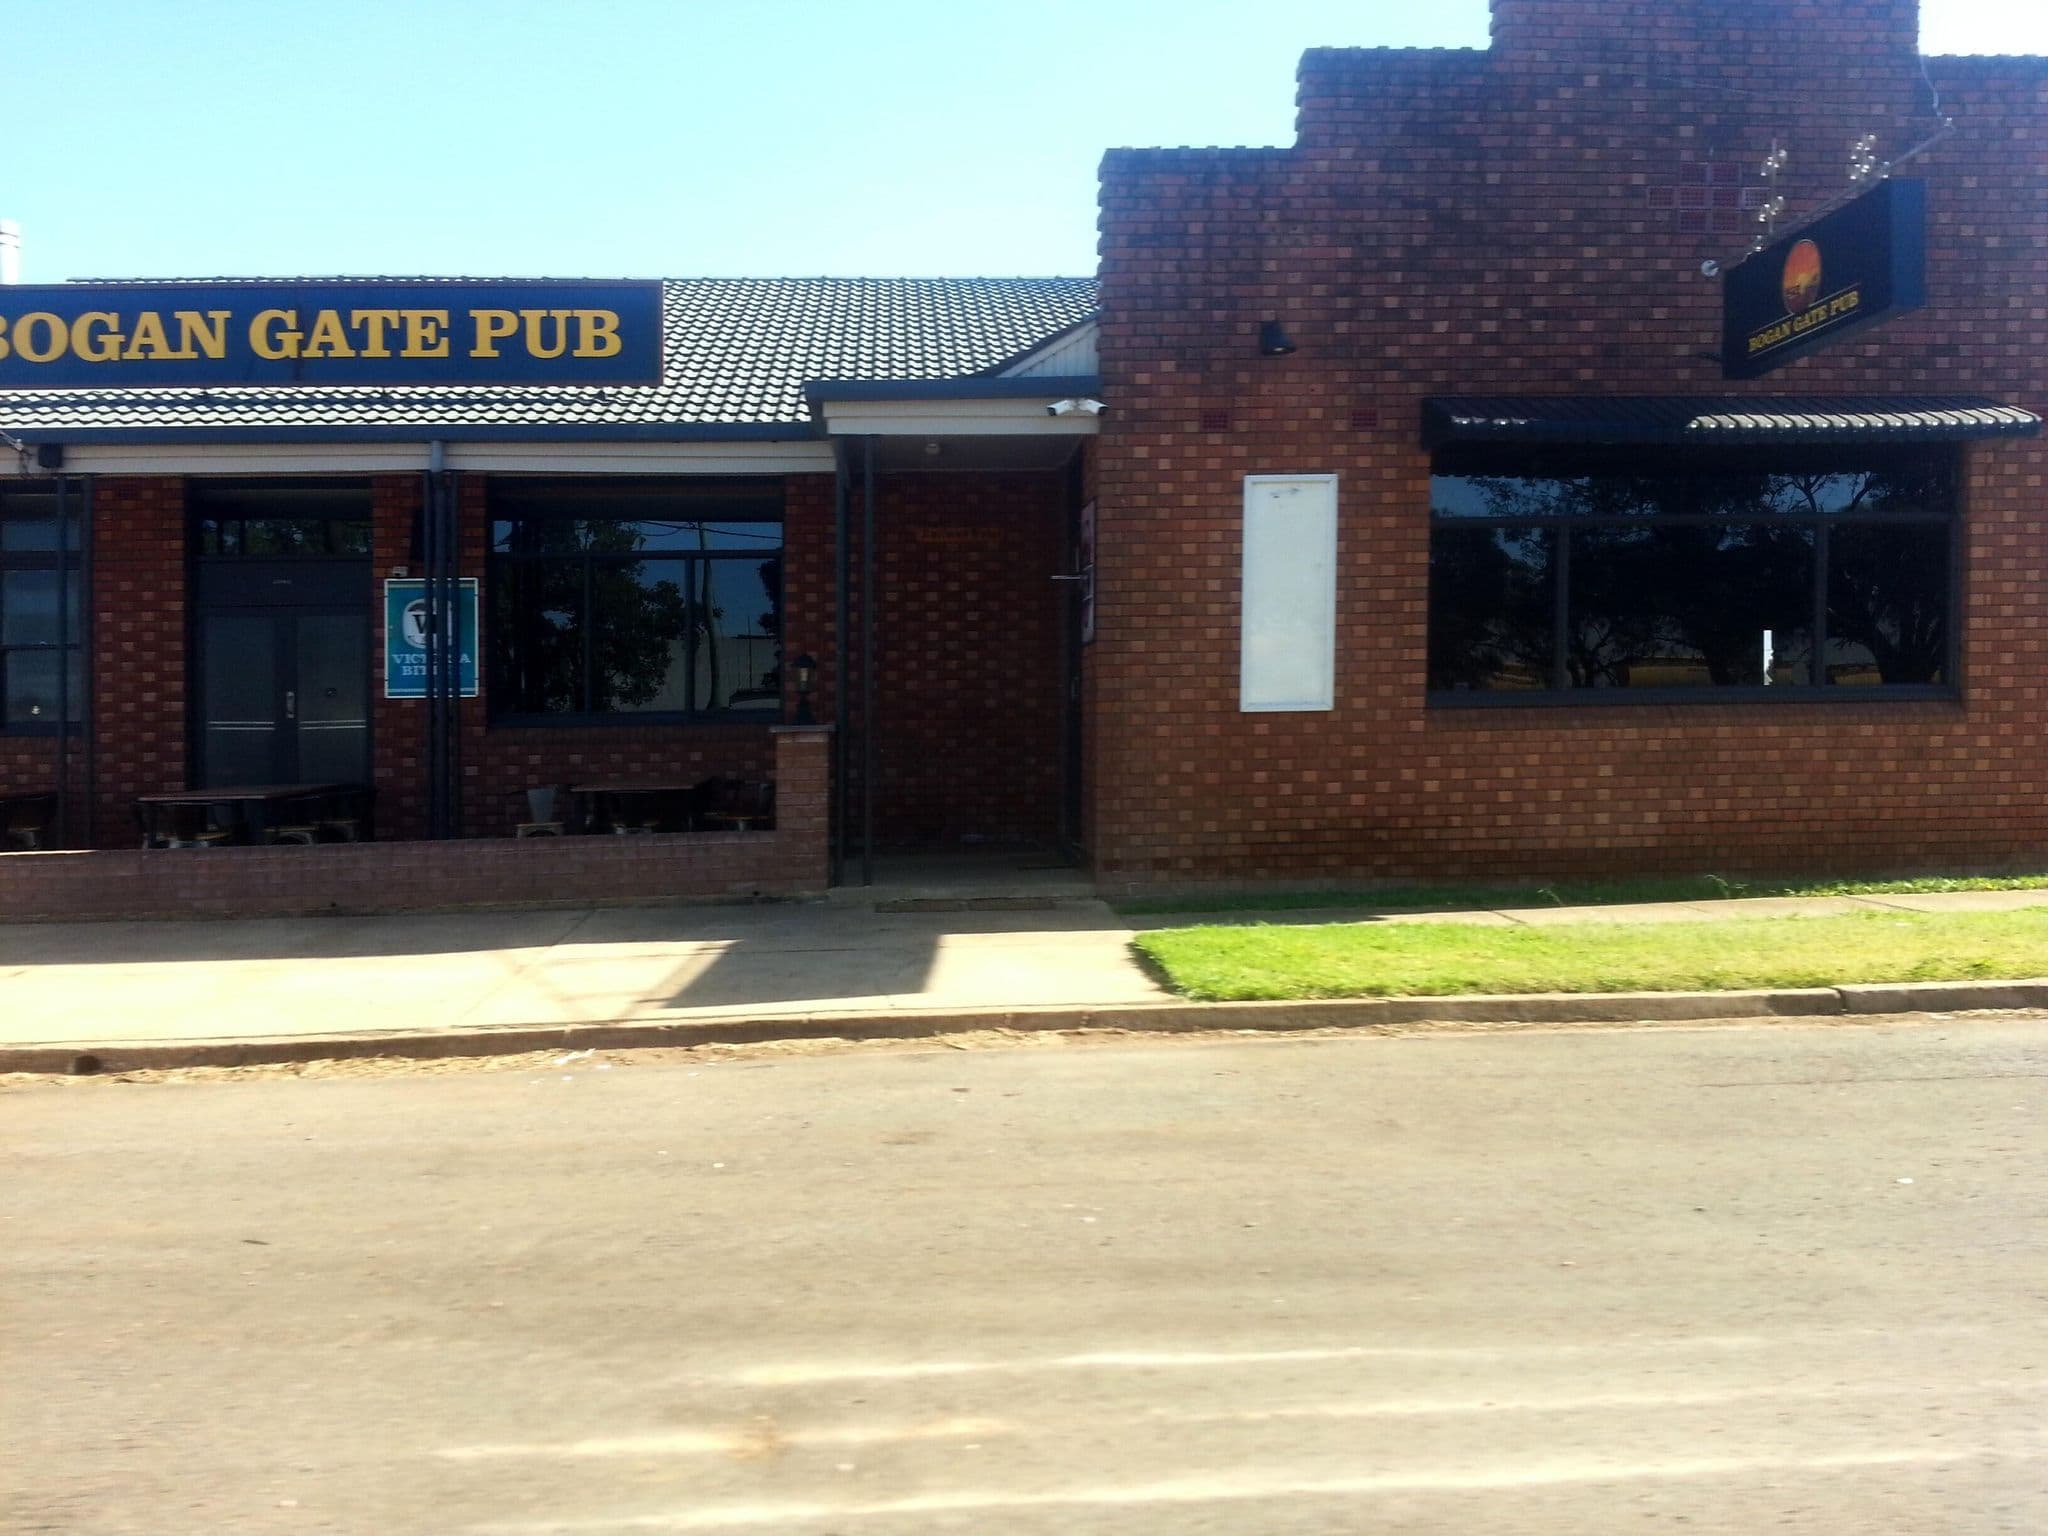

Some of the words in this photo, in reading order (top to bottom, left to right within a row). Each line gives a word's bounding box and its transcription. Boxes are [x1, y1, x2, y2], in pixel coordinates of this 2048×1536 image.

[249, 310, 450, 359] GATE
[469, 309, 622, 358] PUB
[1748, 320, 1792, 352] BOGAN
[1793, 305, 1828, 332] GATE
[1830, 290, 1859, 316] PUB
